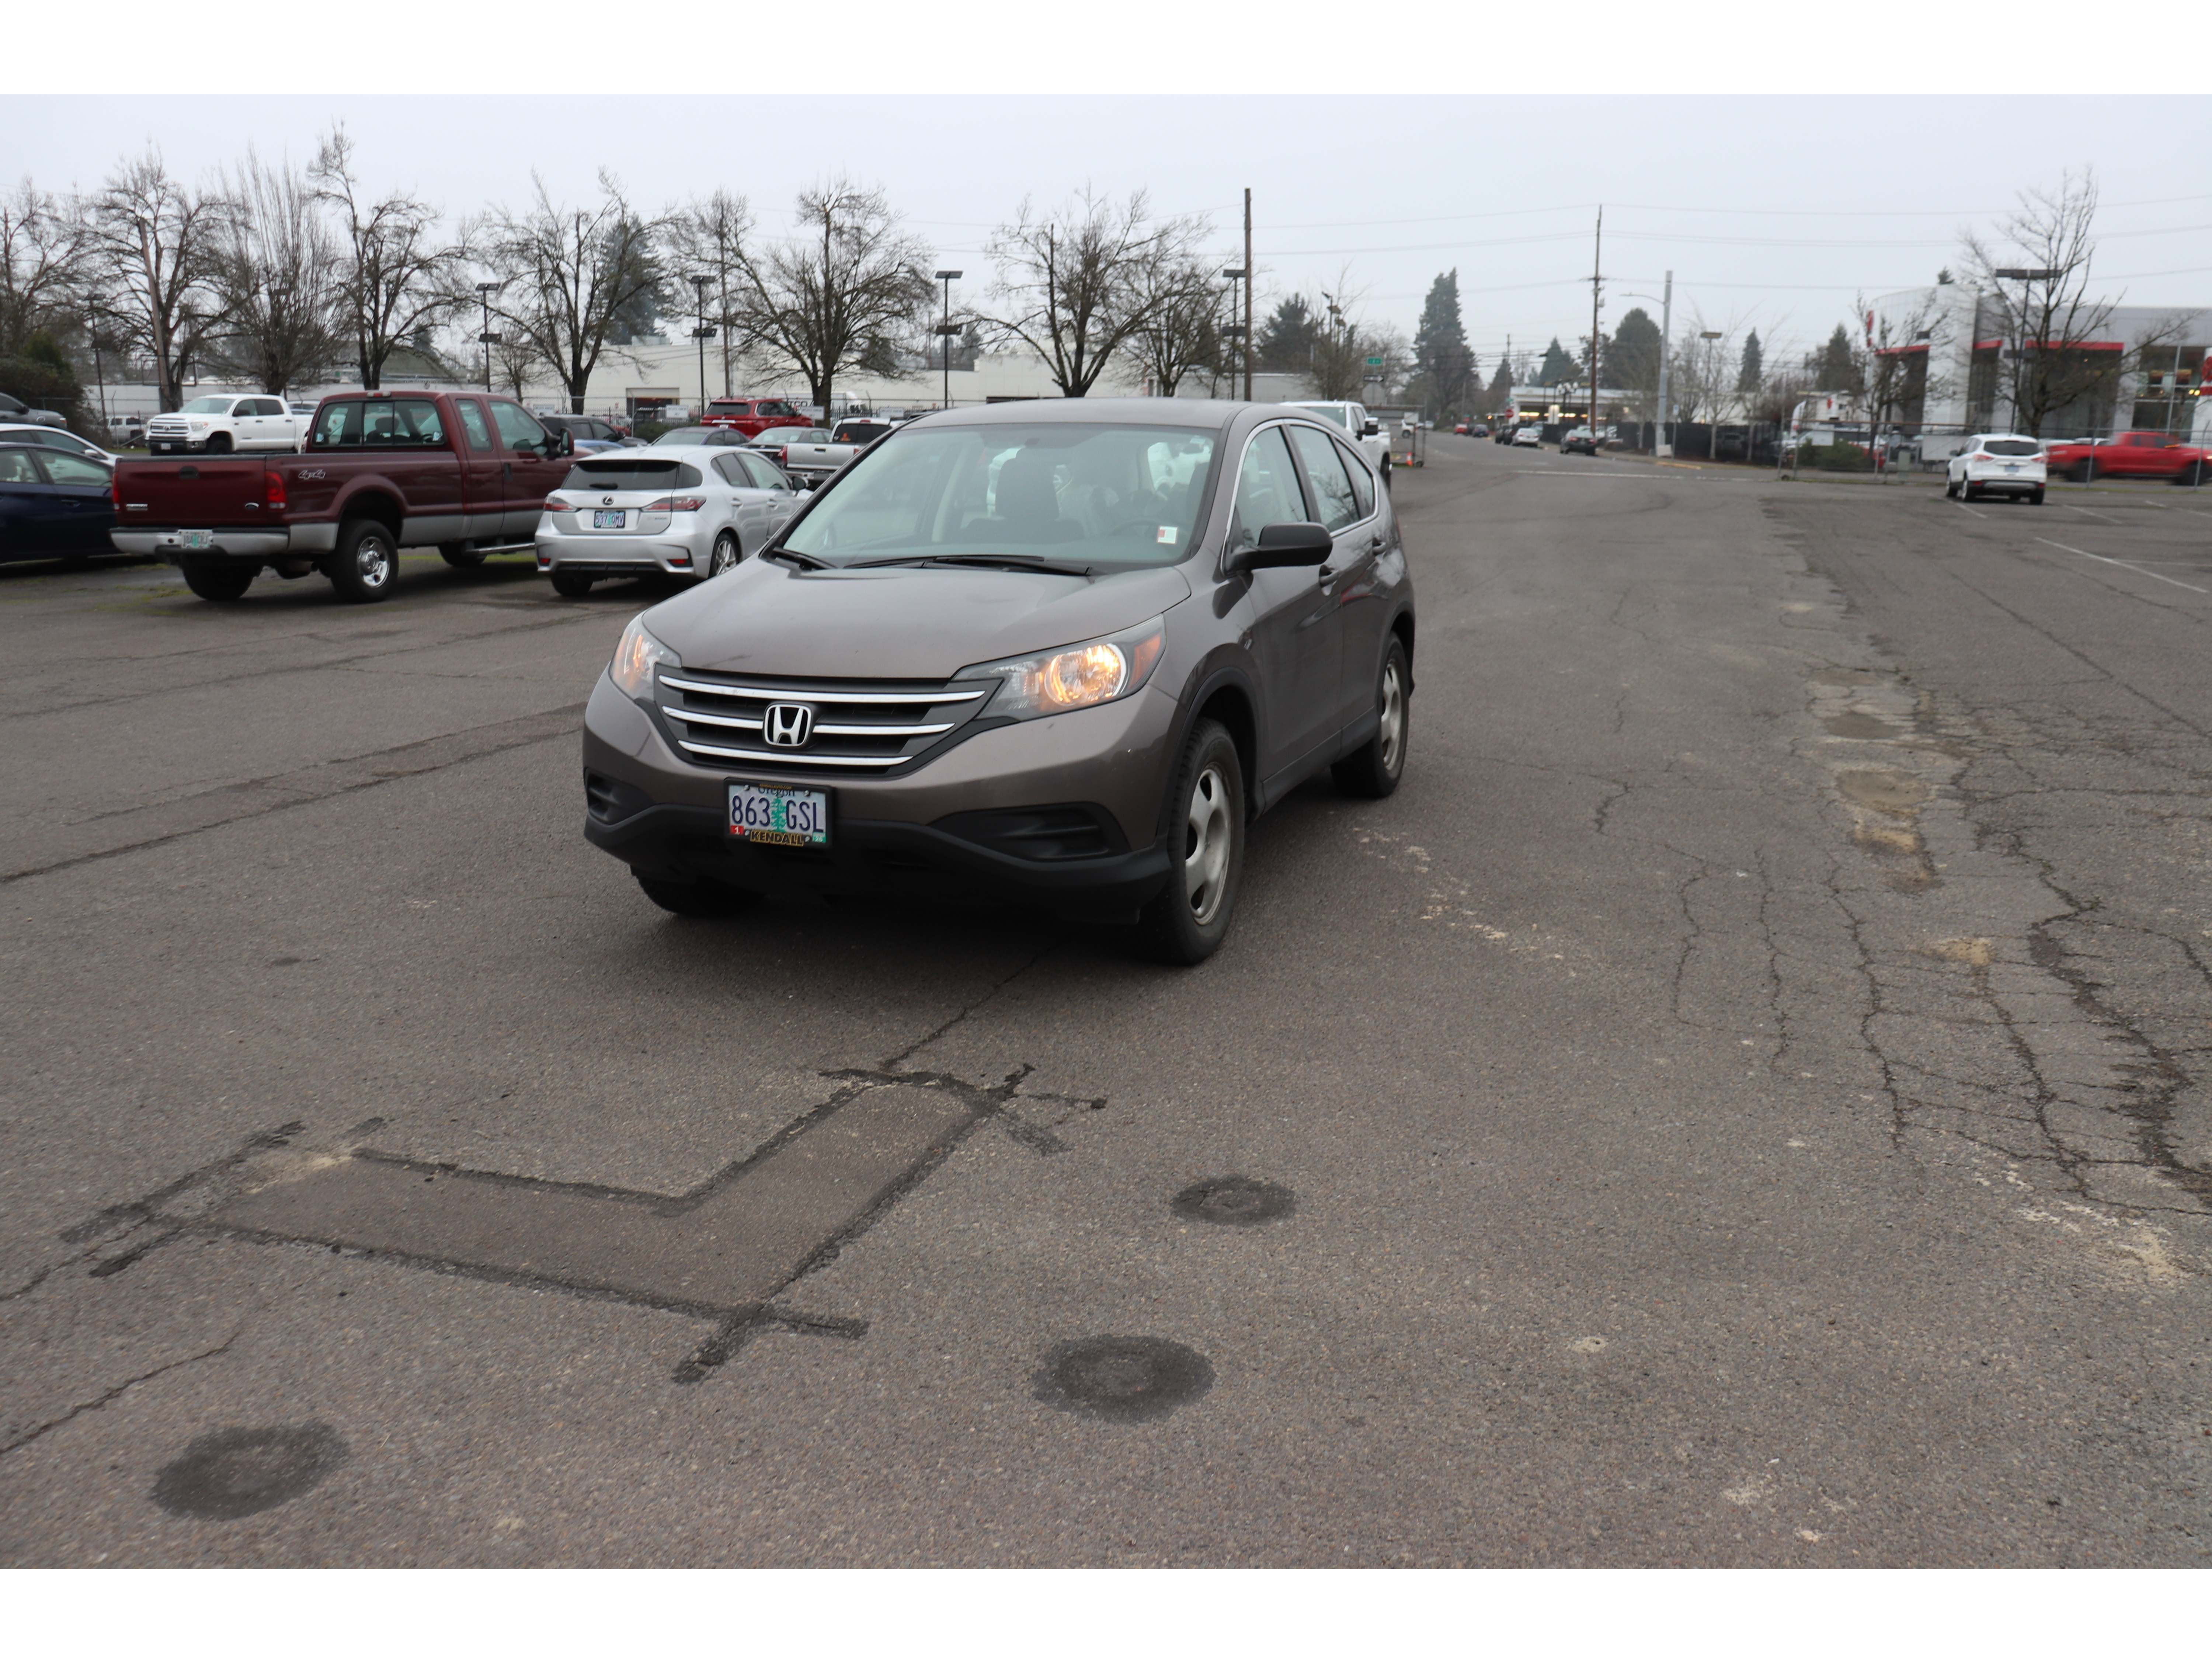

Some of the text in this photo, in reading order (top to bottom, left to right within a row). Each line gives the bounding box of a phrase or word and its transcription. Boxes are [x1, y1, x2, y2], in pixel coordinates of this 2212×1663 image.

[298, 469, 326, 480] 4x4
[732, 795, 823, 833] 863 GSL
[750, 830, 804, 846] KENDALL
